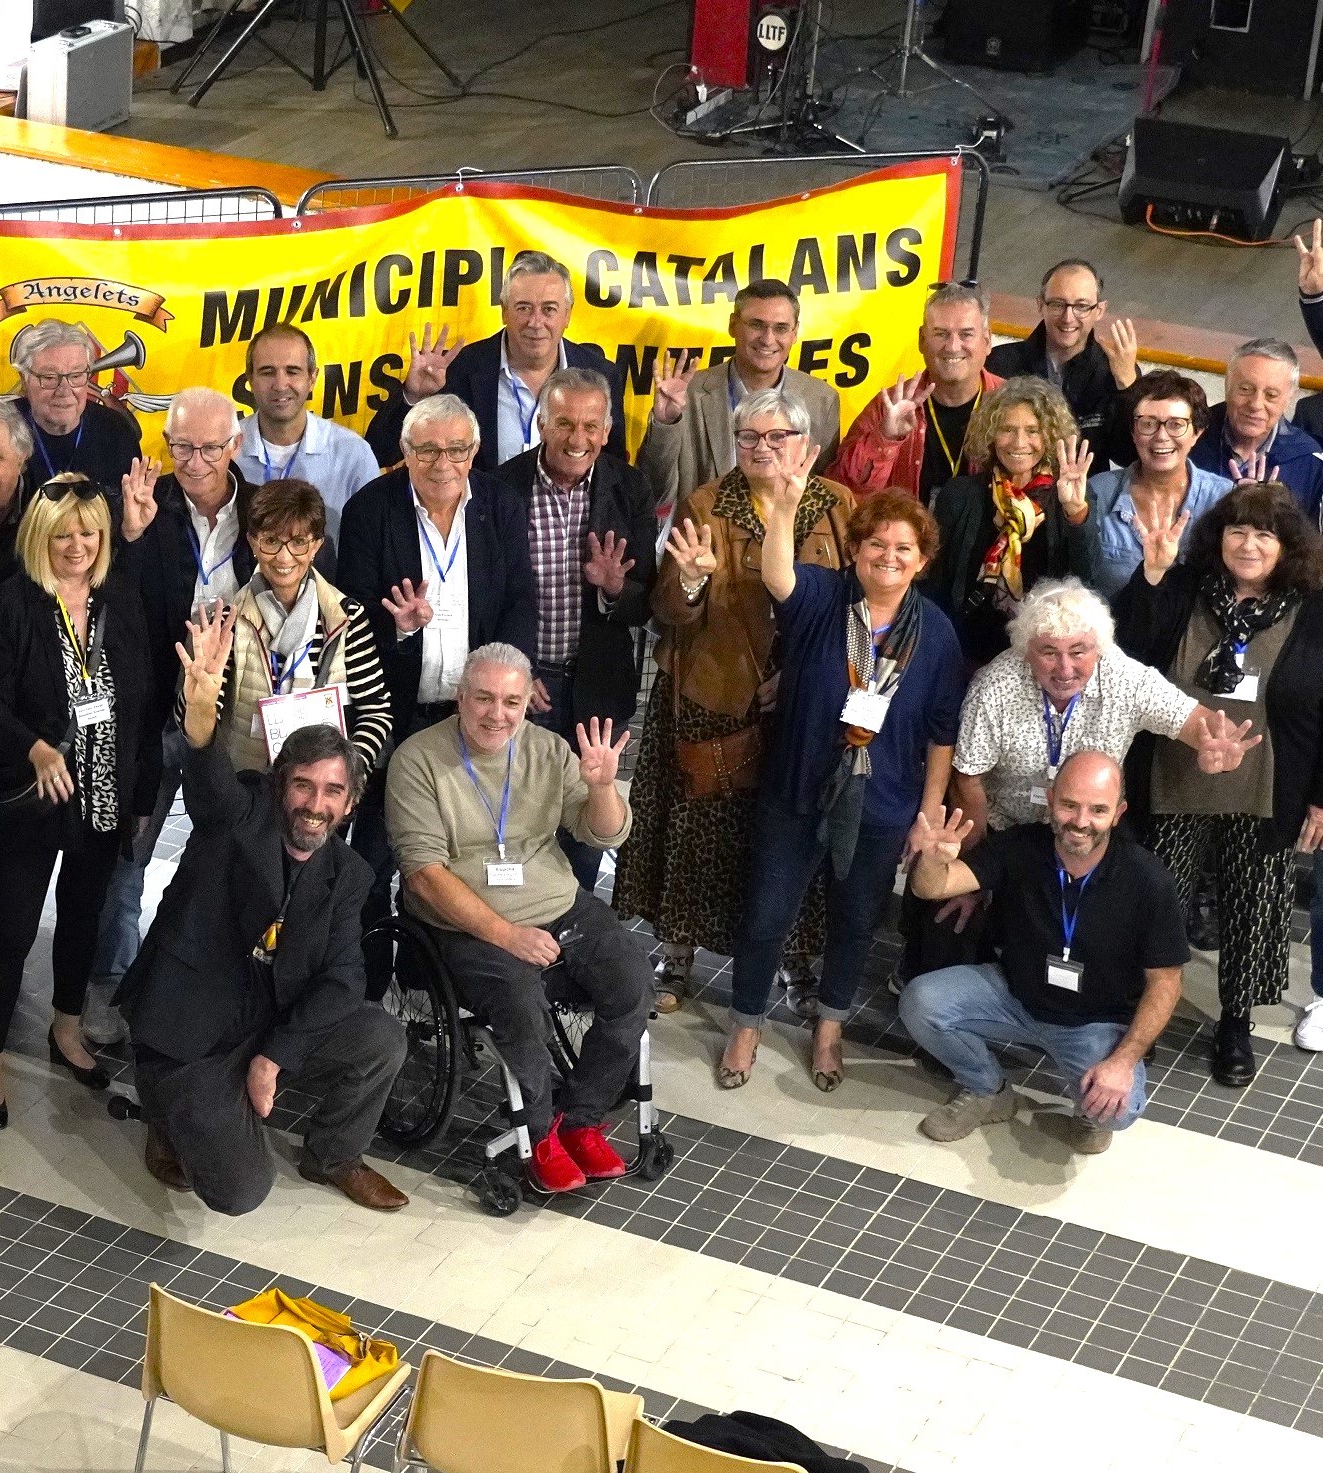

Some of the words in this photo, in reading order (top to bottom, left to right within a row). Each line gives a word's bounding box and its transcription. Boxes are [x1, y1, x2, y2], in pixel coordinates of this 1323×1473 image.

[758, 23, 786, 41] LLTF
[584, 227, 922, 308] CATALANS
[23, 281, 140, 306] Angelets
